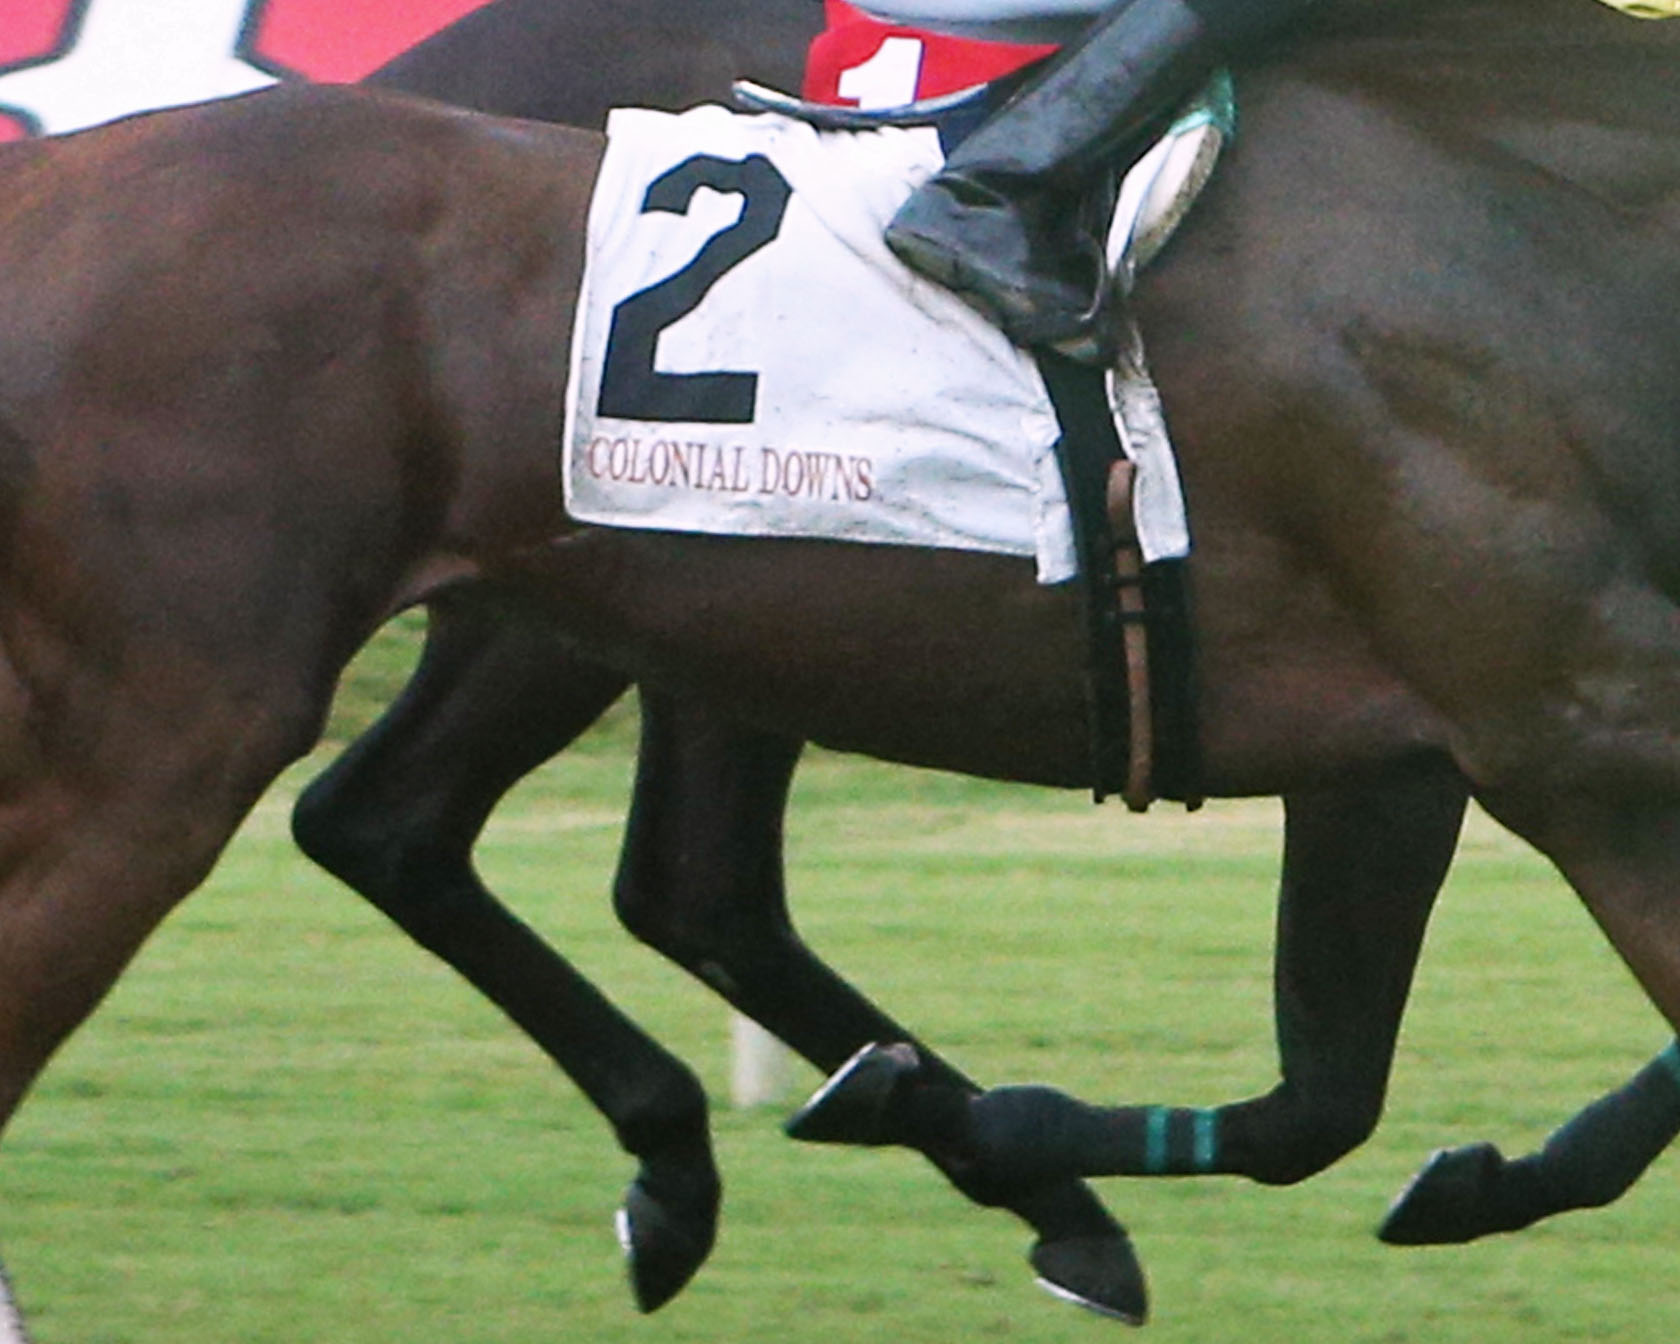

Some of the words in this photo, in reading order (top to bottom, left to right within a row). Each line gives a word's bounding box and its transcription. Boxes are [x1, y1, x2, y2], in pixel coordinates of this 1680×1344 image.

[596, 152, 793, 425] 2
[587, 435, 750, 493] COLONIAL
[760, 447, 873, 503] DOWNS
